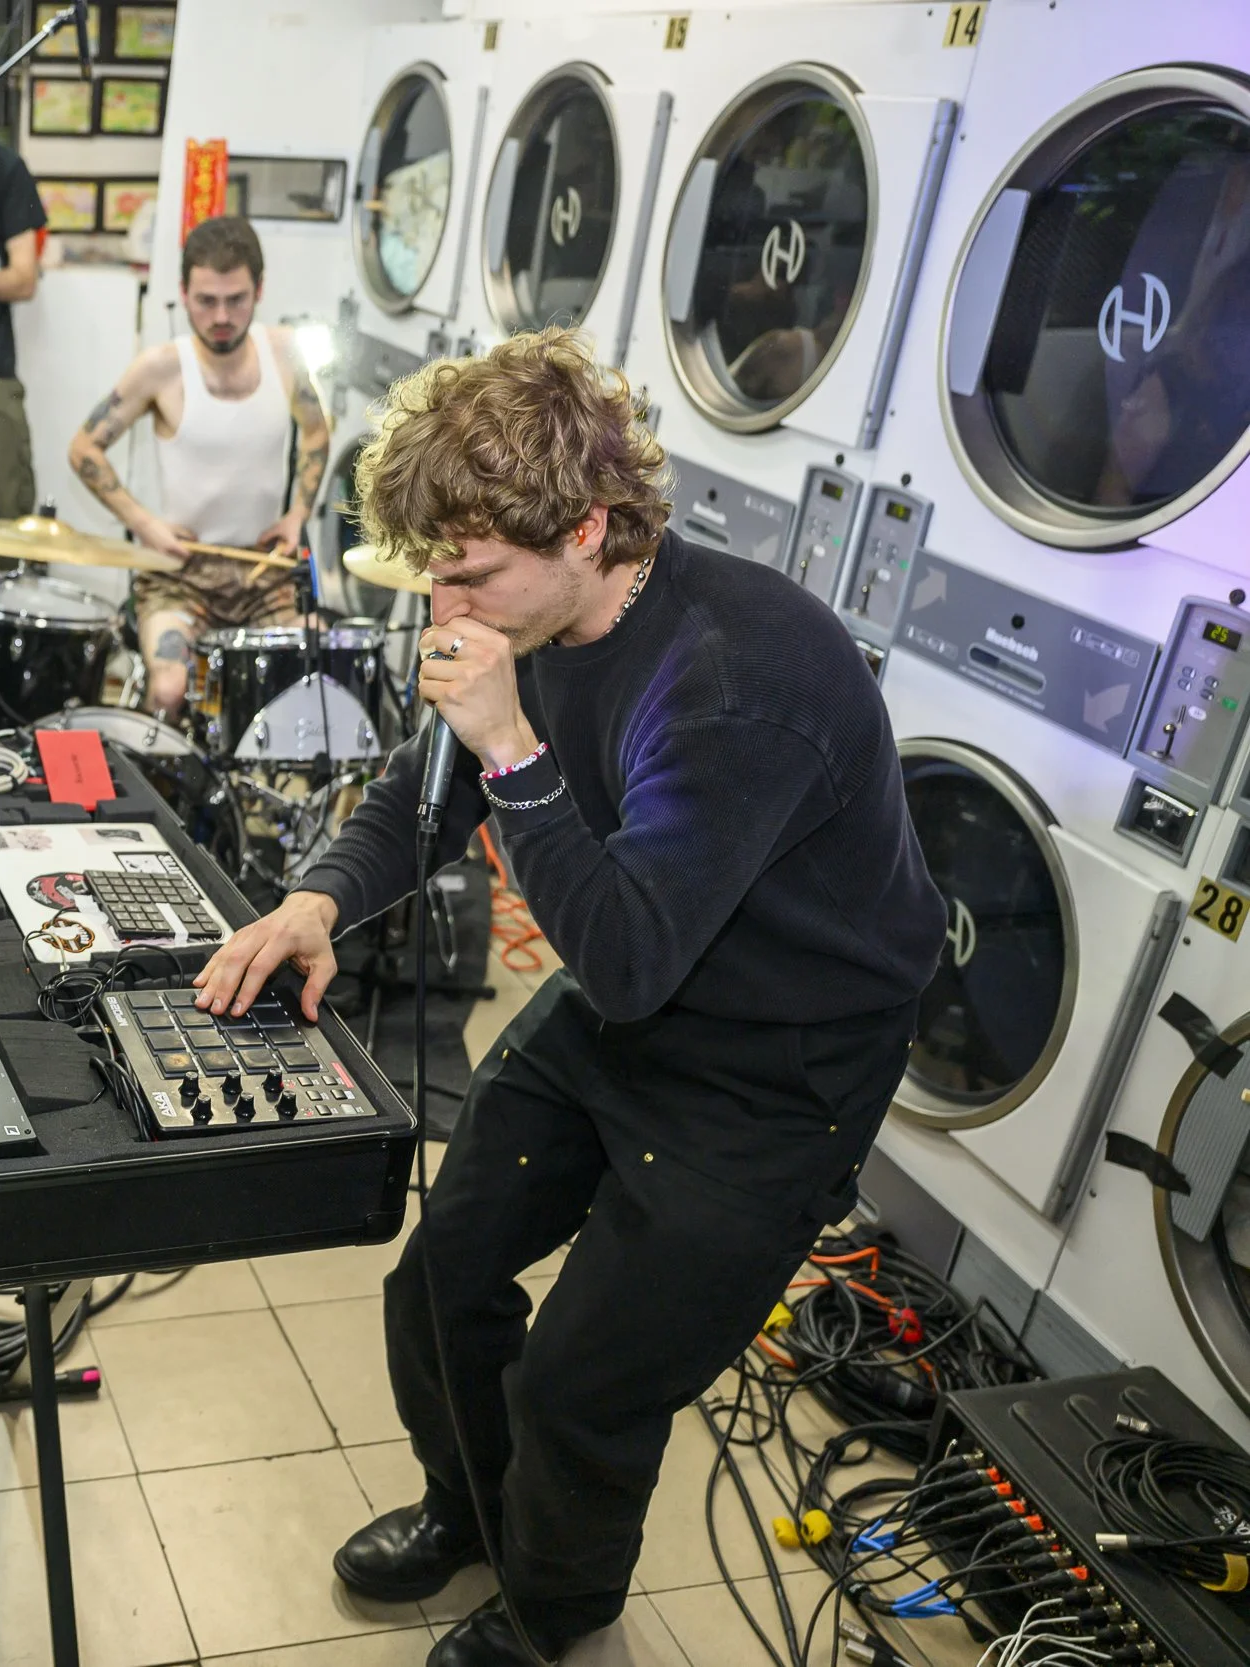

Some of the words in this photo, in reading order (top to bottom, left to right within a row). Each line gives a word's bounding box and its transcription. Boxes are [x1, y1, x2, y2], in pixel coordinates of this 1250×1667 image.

[949, 5, 980, 45] 14
[1210, 624, 1229, 643] 25
[1193, 884, 1243, 934] 28
[151, 1091, 177, 1118] AKAI
